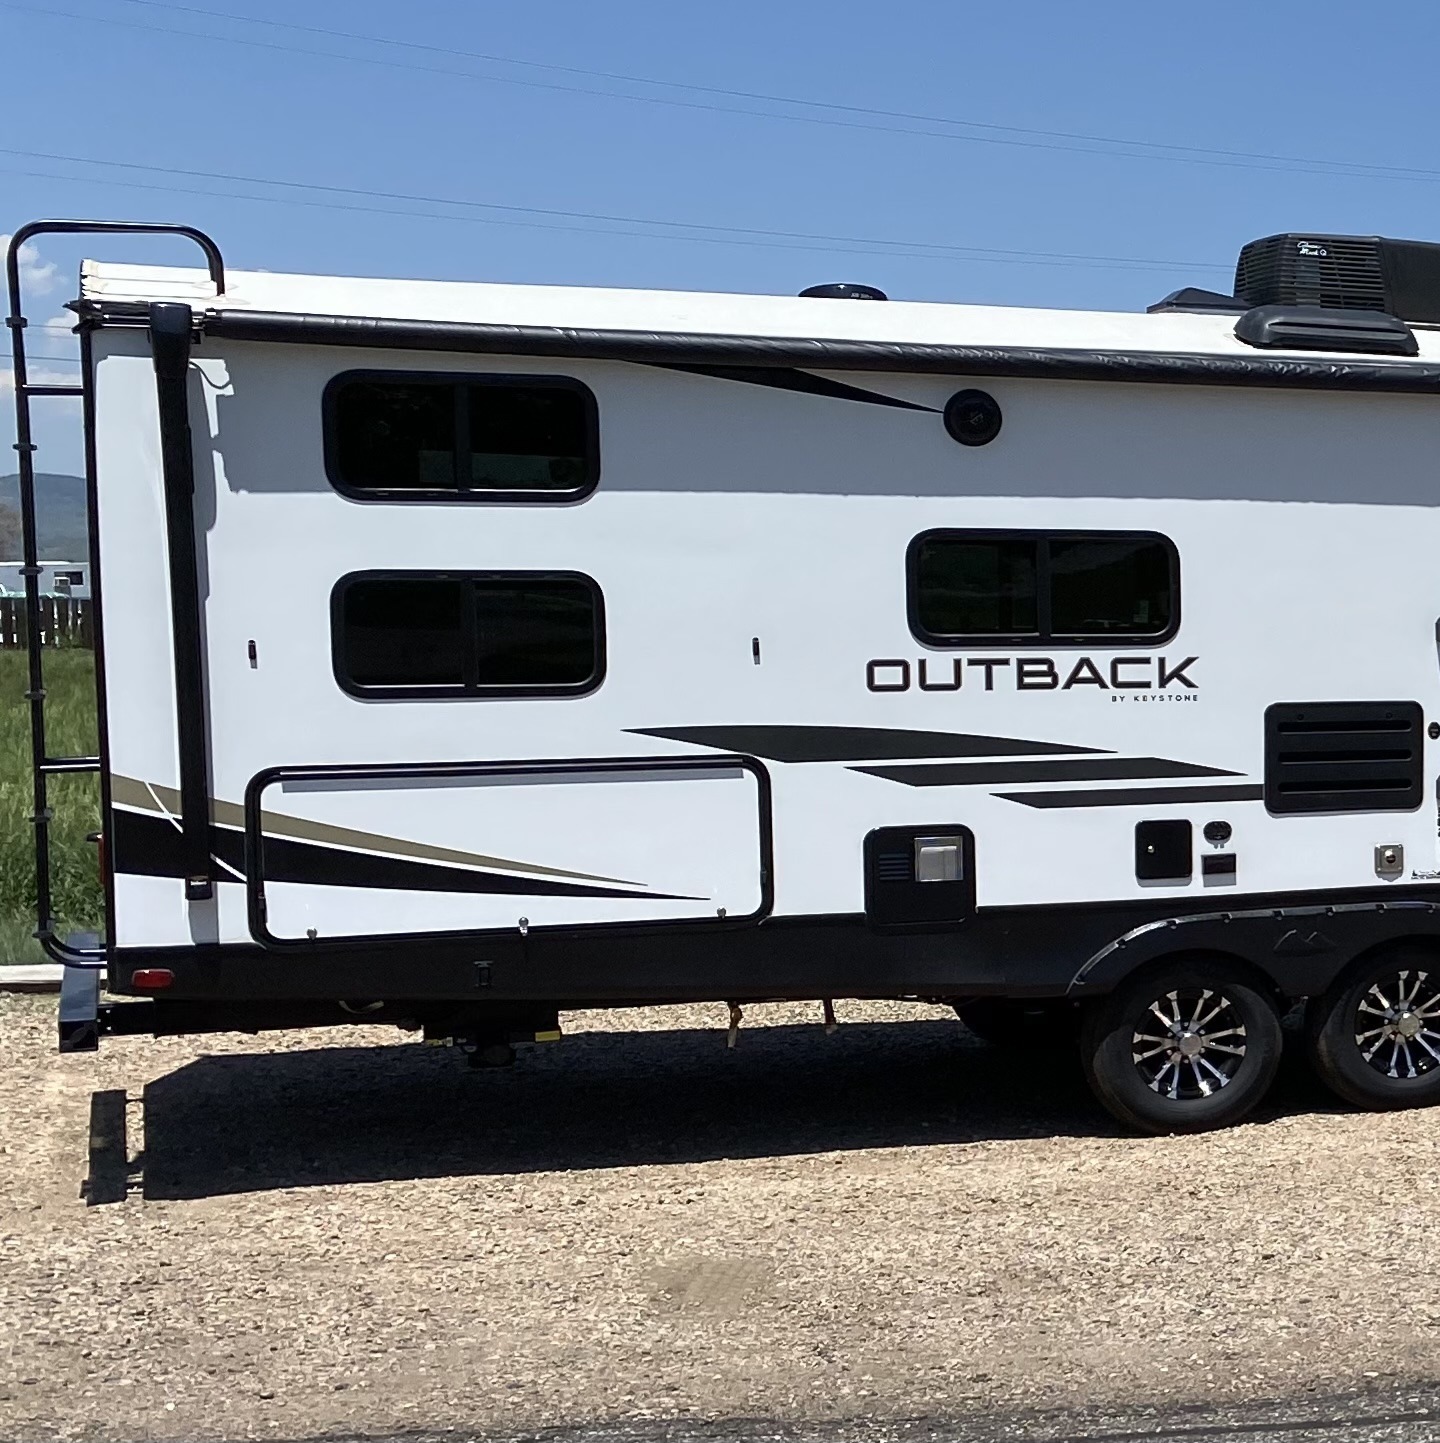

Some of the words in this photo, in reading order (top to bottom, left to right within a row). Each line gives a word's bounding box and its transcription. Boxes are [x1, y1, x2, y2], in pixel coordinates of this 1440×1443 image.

[866, 656, 1200, 692] OUTBACK
[1111, 695, 1126, 703] BY
[1133, 694, 1199, 702] KEYSTONE
